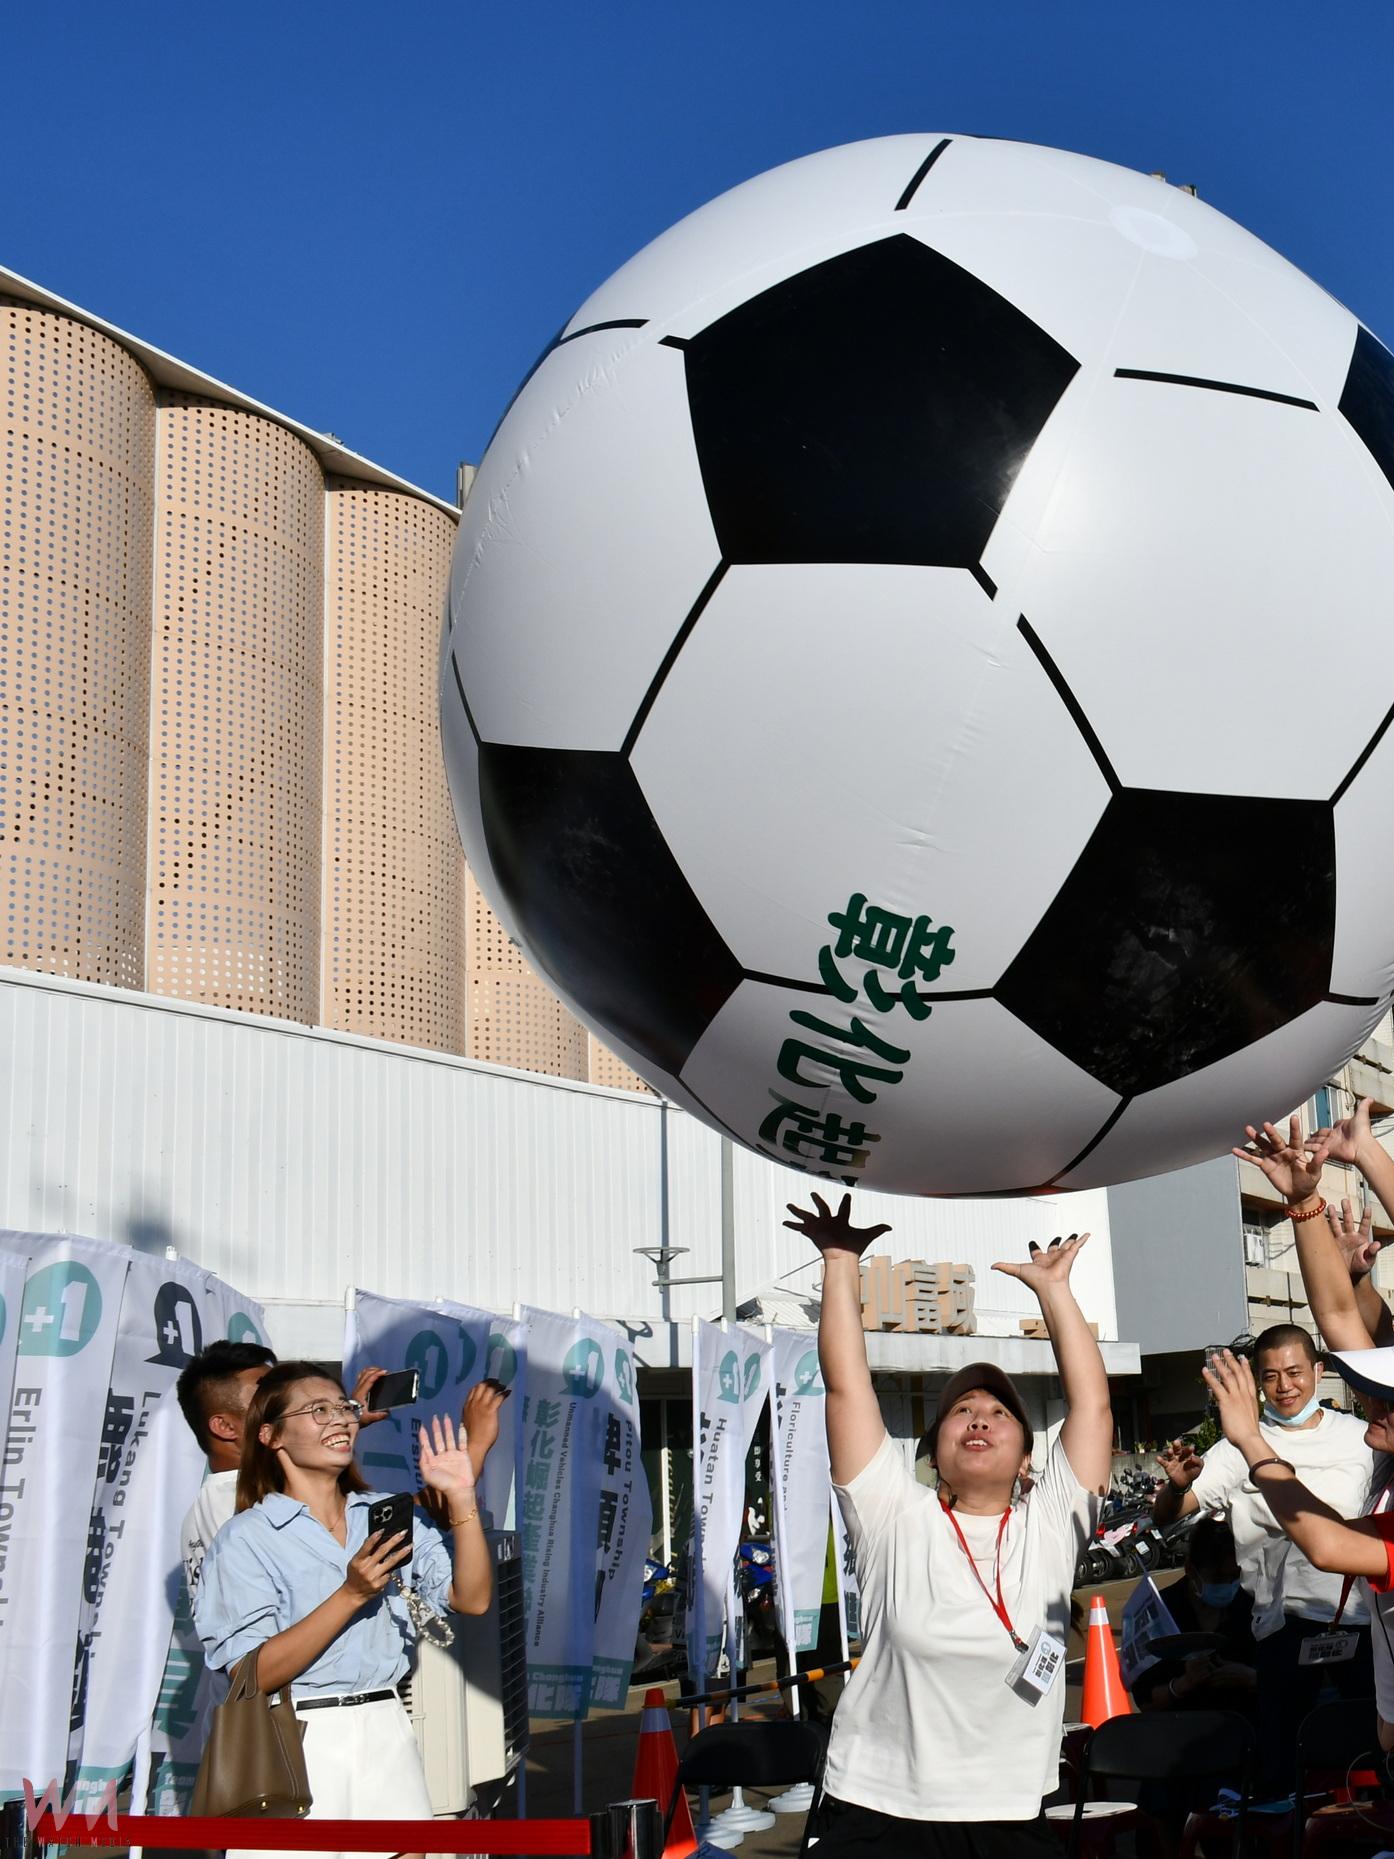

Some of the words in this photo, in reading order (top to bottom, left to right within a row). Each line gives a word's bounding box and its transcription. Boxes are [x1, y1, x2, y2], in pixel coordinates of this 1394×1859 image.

[758, 893, 956, 1188] 彰化起
[4, 1388, 42, 1466] Erlin
[112, 1391, 162, 1507] Lukang
[562, 1402, 576, 1449] Unmanned
[704, 1418, 728, 1485] Huatan
[782, 1401, 801, 1482] Floriculture
[548, 1491, 561, 1538] Changhua
[609, 1481, 633, 1581] Township
[534, 1610, 545, 1648] Alliance
